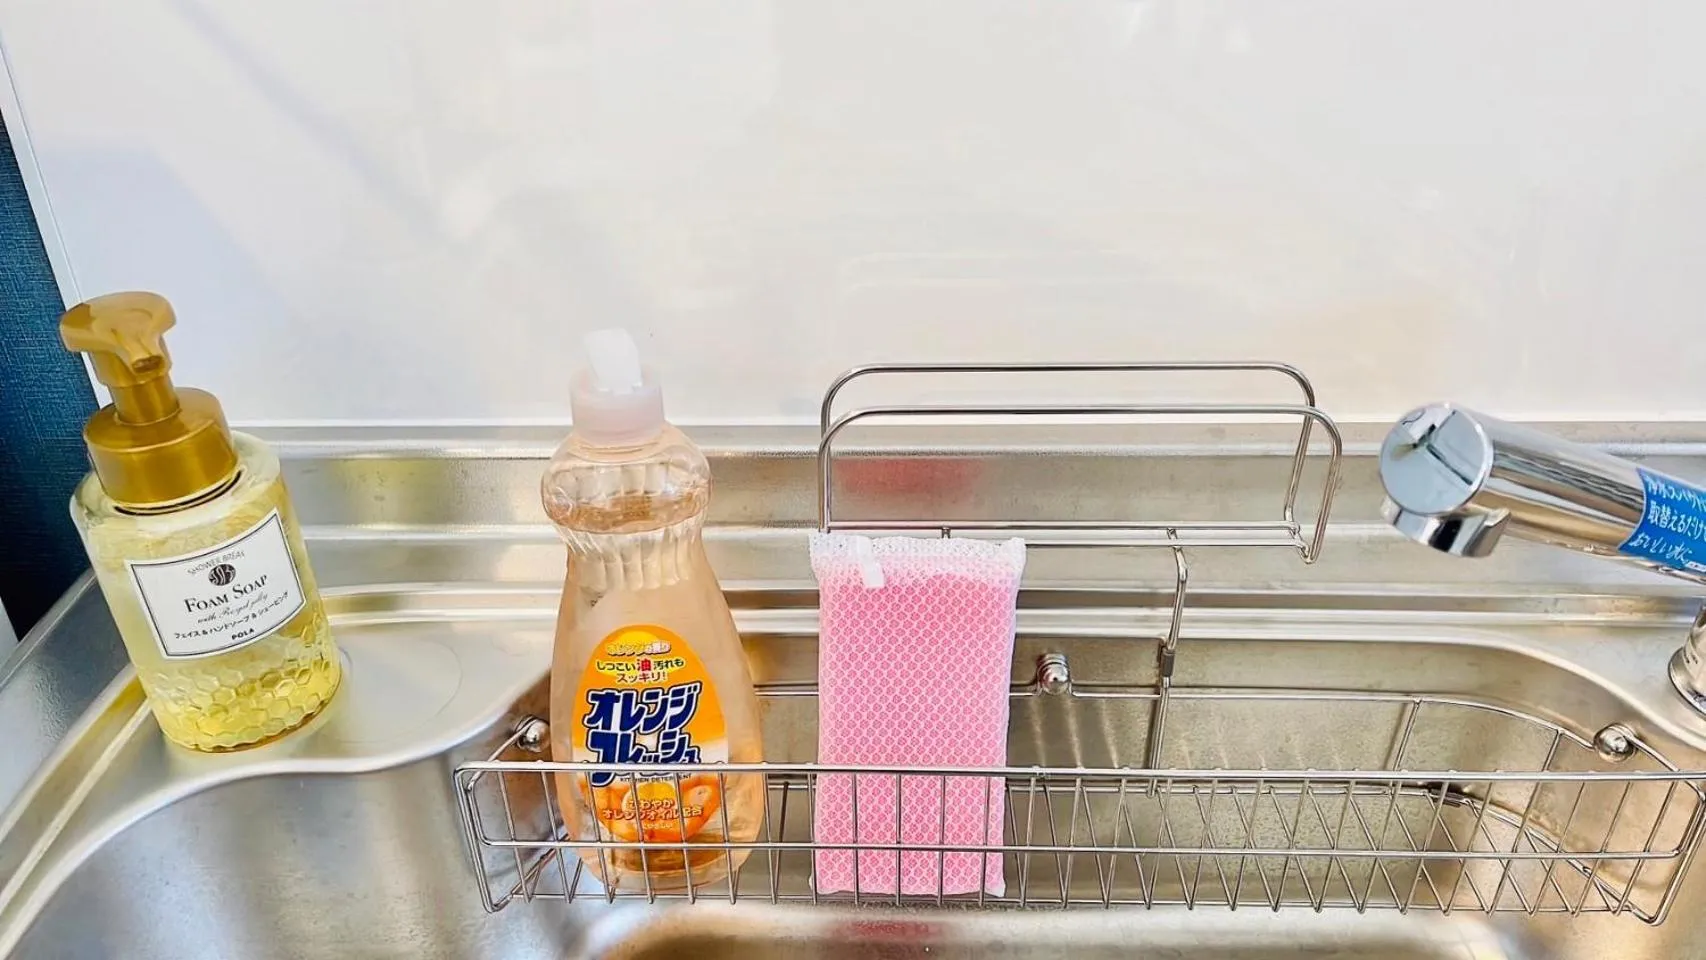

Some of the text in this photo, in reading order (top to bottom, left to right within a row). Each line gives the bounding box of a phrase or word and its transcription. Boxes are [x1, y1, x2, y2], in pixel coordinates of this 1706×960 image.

[184, 574, 268, 613] FOAM SOAP
[231, 628, 255, 641] POLA
[582, 680, 702, 735] オレンジ
